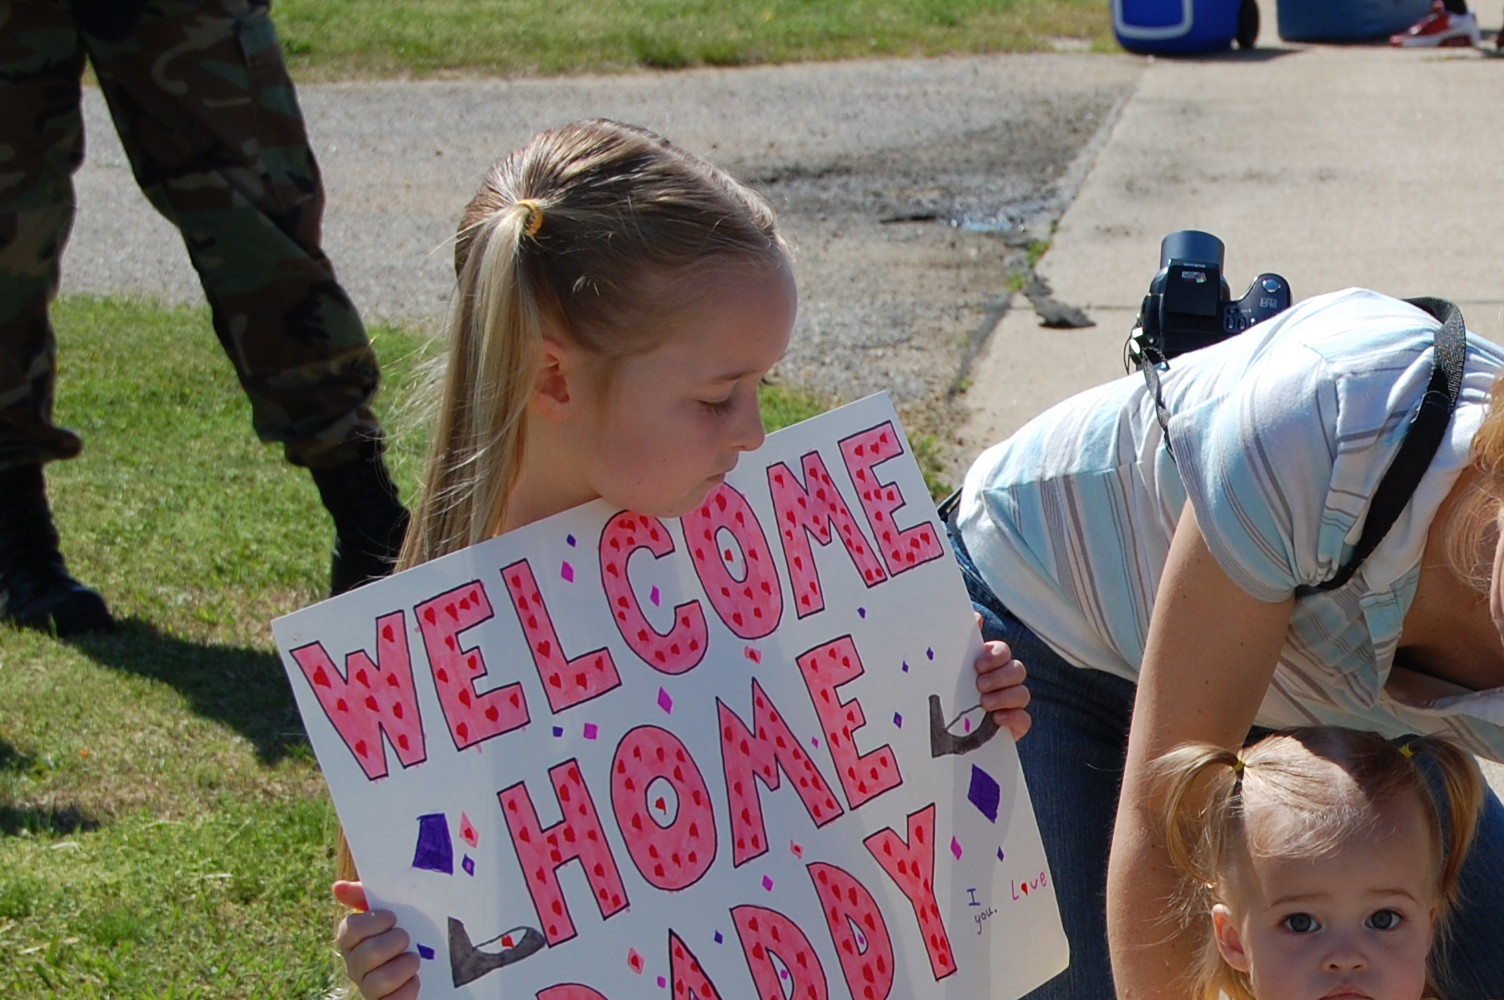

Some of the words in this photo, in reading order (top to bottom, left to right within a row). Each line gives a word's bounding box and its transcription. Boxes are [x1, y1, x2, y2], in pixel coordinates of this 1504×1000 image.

[288, 420, 945, 783] WELCOME
[497, 634, 904, 950] HOME
[966, 887, 981, 907] I
